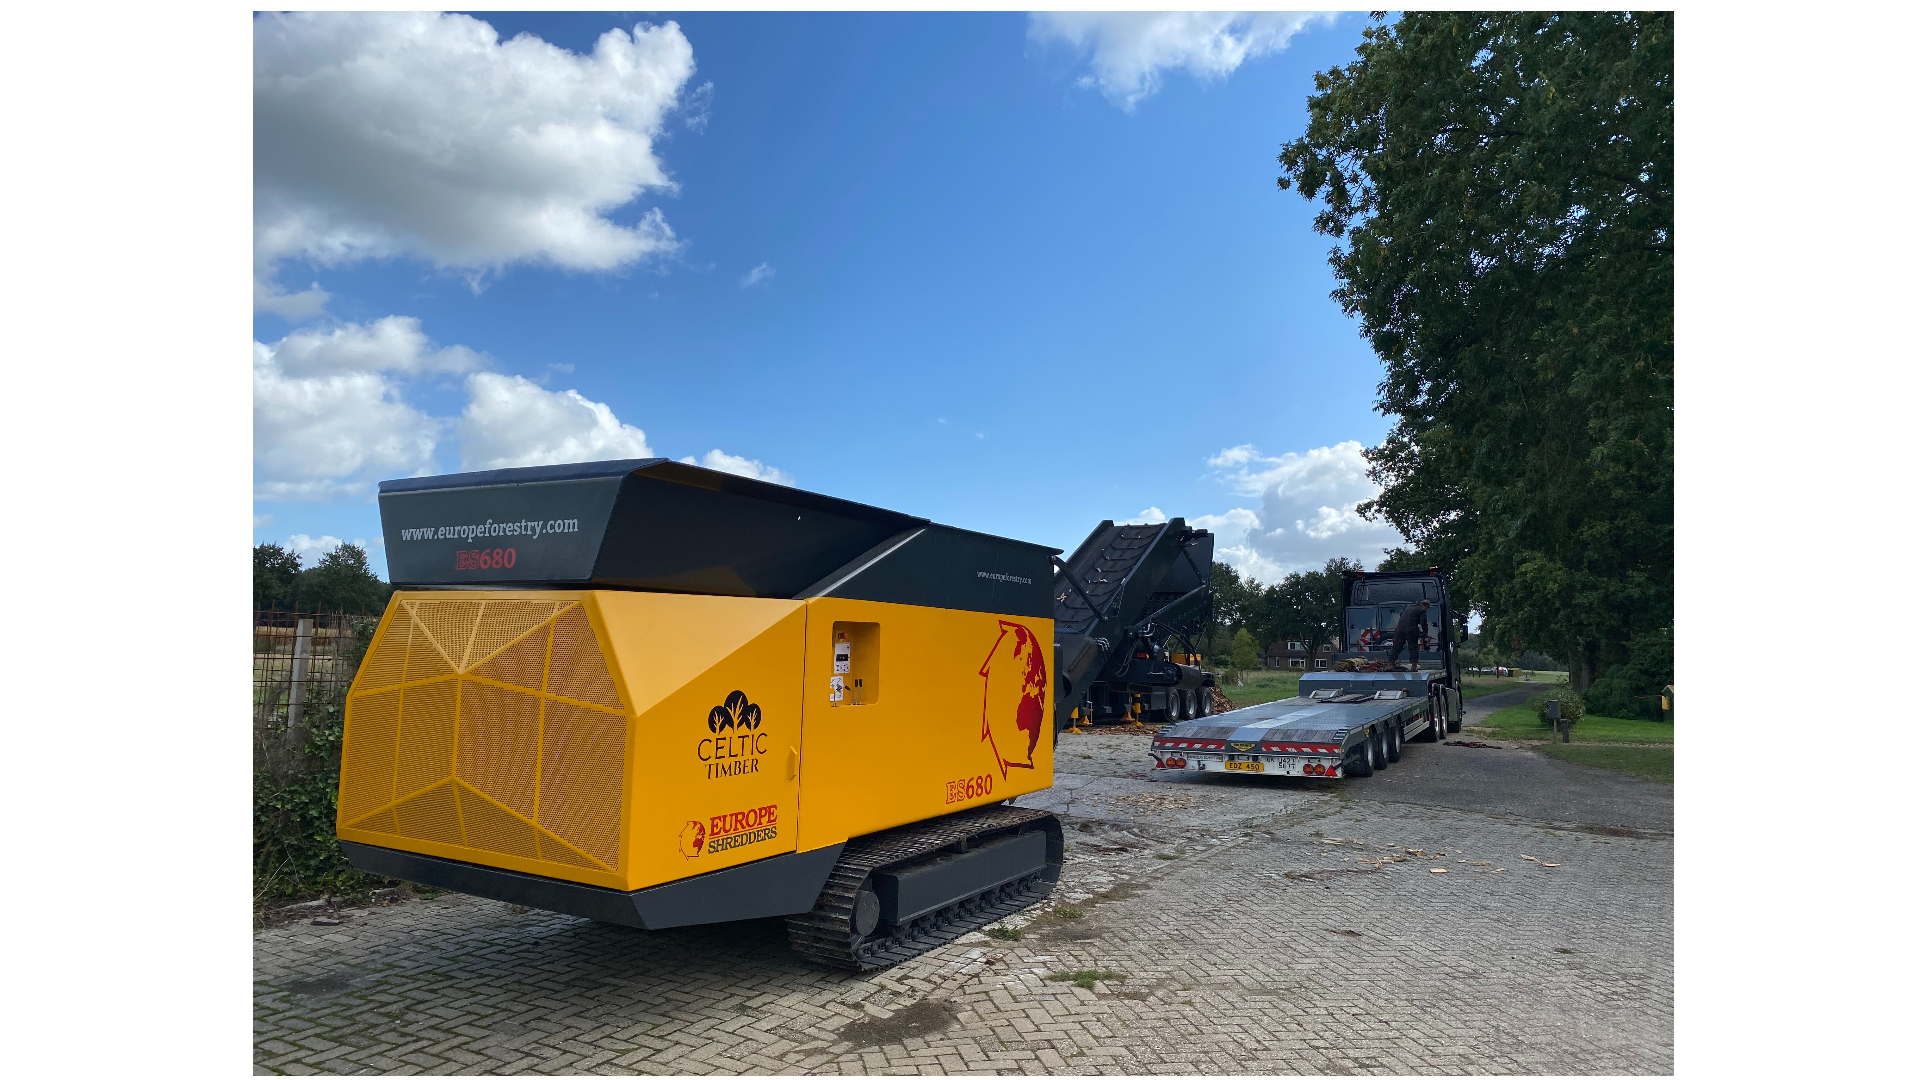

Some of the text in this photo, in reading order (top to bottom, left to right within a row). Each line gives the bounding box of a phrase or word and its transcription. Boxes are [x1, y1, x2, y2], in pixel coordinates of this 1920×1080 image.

[401, 518, 579, 543] www.europeforestry.com
[455, 547, 517, 571] ES680
[697, 732, 768, 762] CELTIC
[704, 758, 760, 780] TIMBER
[1229, 762, 1260, 771] EDZ 450
[945, 773, 993, 805] ES680
[709, 804, 778, 838] EUROPE
[708, 826, 778, 854] SHREDDERS
